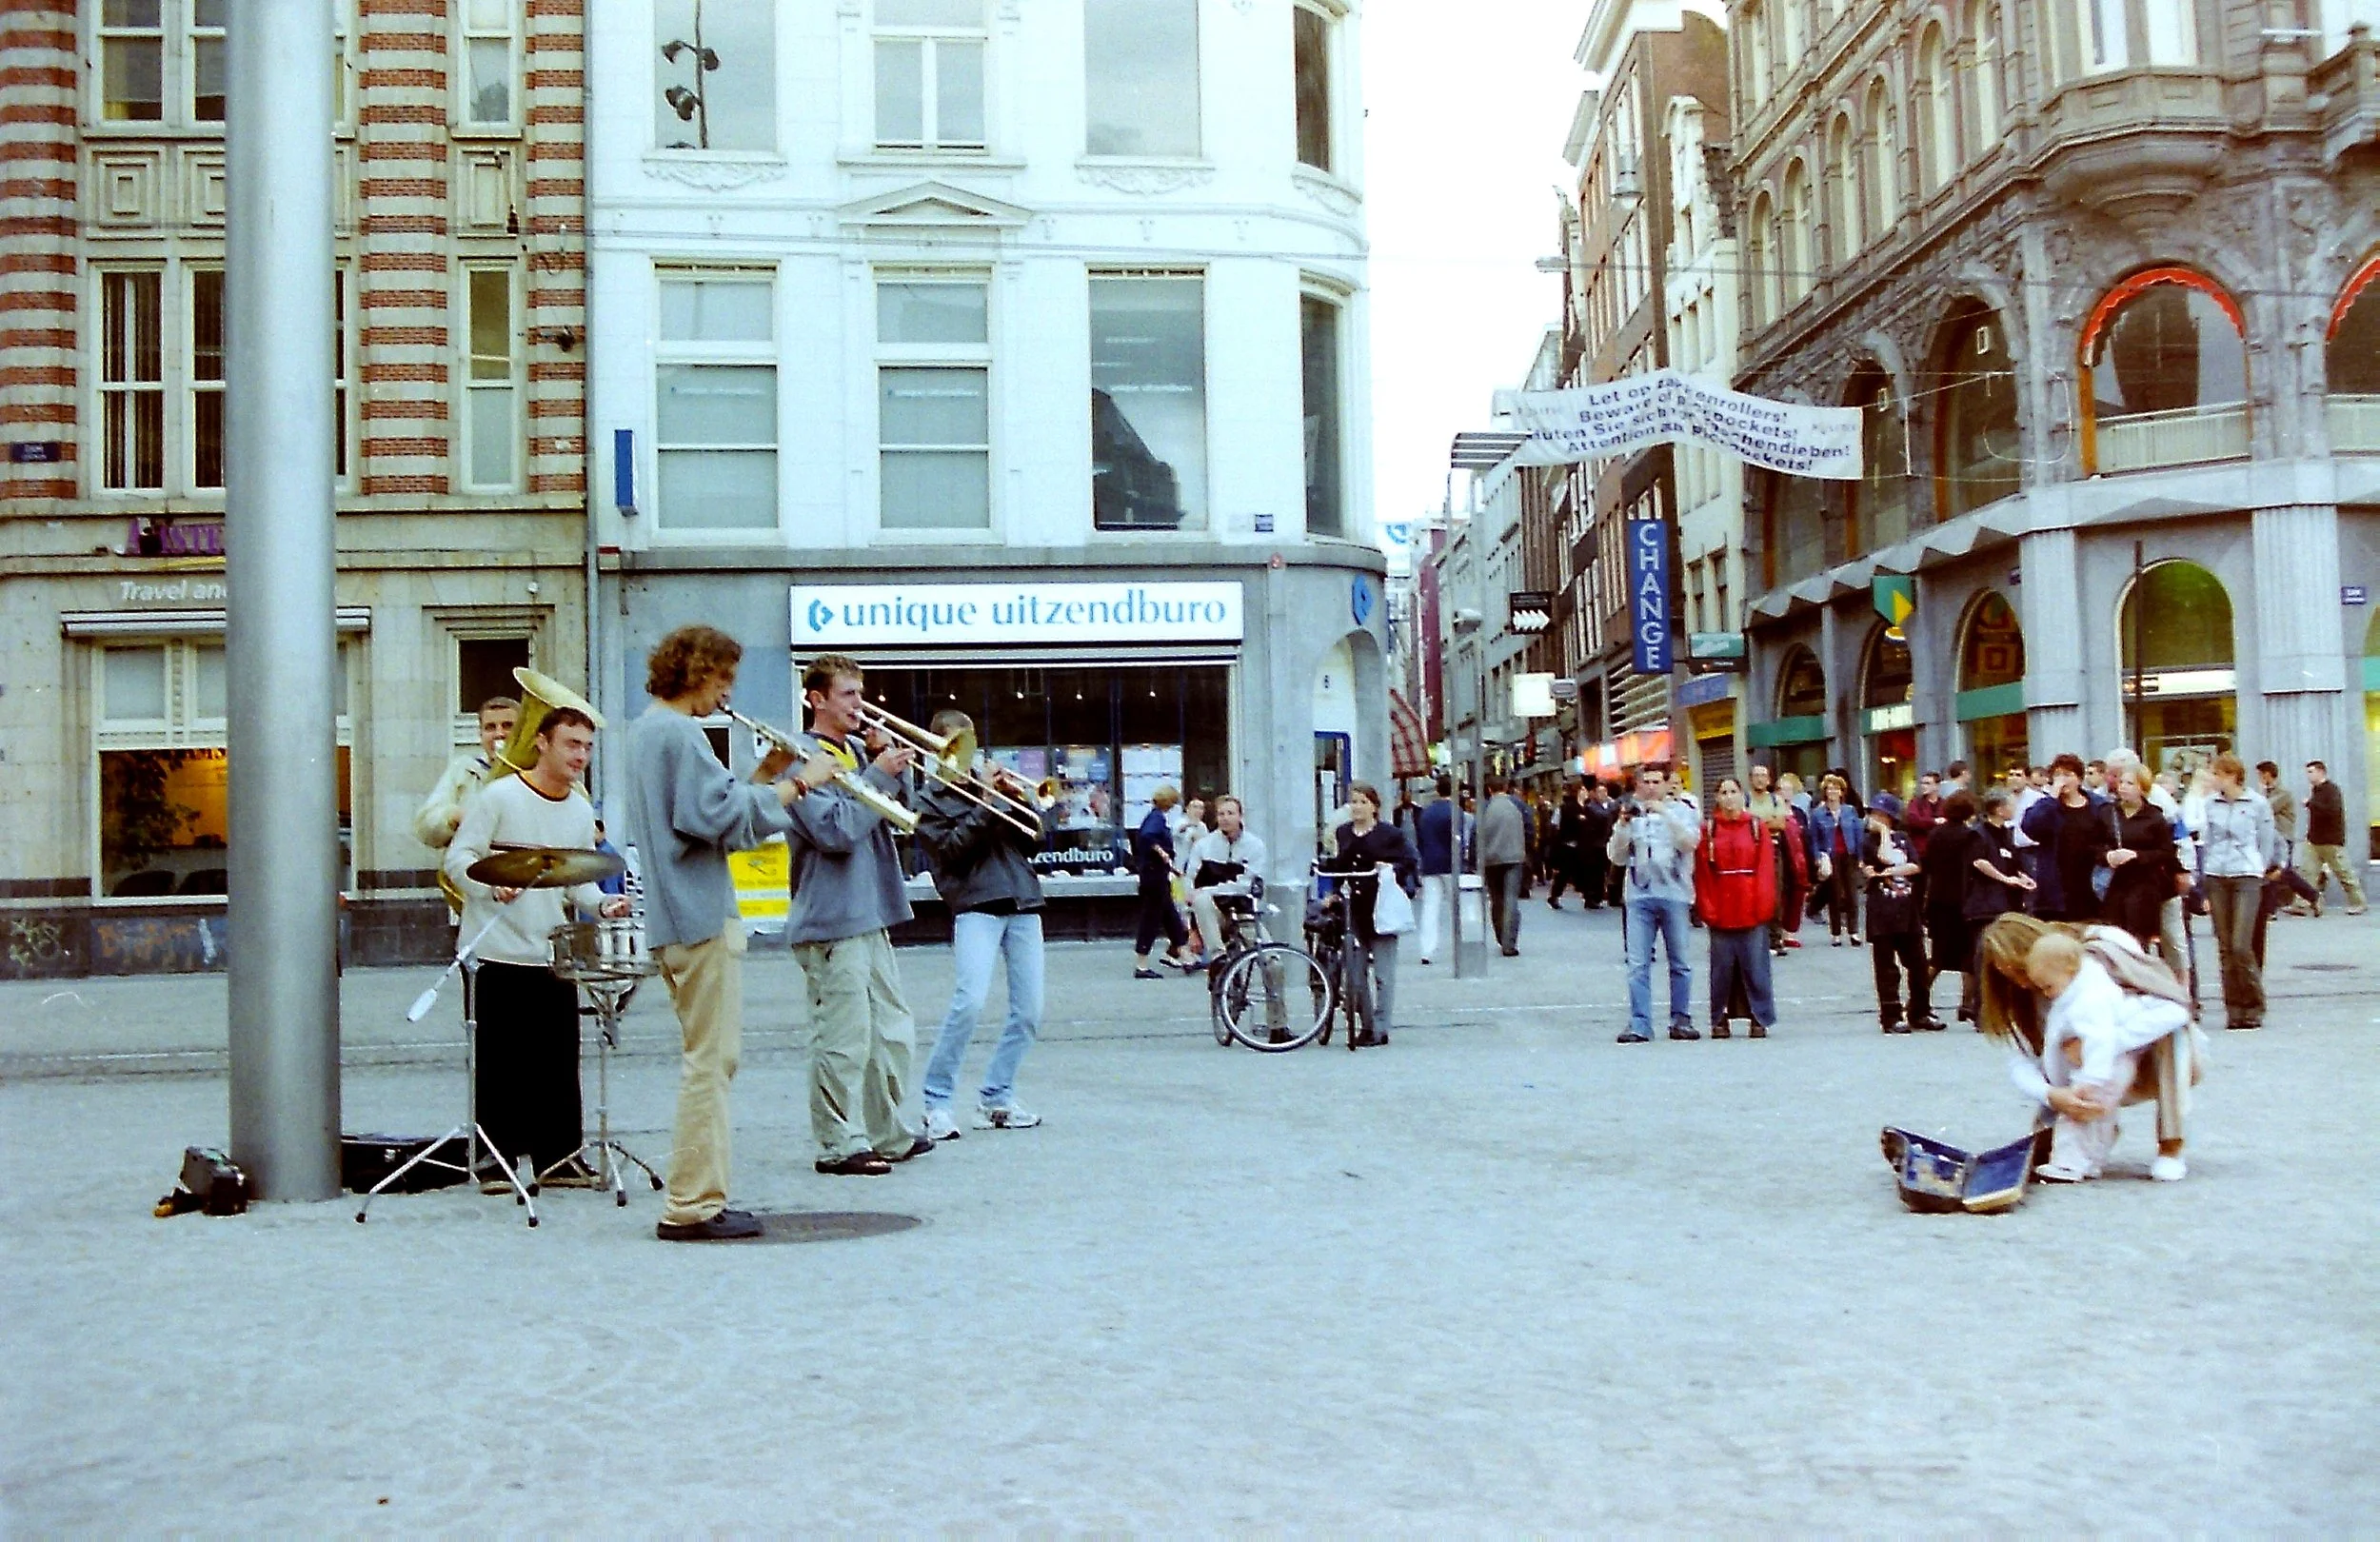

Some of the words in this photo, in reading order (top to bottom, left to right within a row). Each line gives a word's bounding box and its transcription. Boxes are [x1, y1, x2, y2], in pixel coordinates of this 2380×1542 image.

[1579, 397, 1652, 424] Beware
[1657, 390, 1673, 404] of
[1589, 390, 1620, 406] Let
[1628, 385, 1652, 399] op
[1594, 421, 1626, 436] Sie
[1568, 425, 1656, 454] Attention
[1692, 424, 1814, 472] picockets!
[119, 579, 188, 602] Travel
[192, 583, 227, 601] an
[1638, 523, 1665, 670] CHANGE
[843, 595, 978, 632] unique
[992, 588, 1227, 625] uitzendburo
[1027, 847, 1115, 864] zendburo
